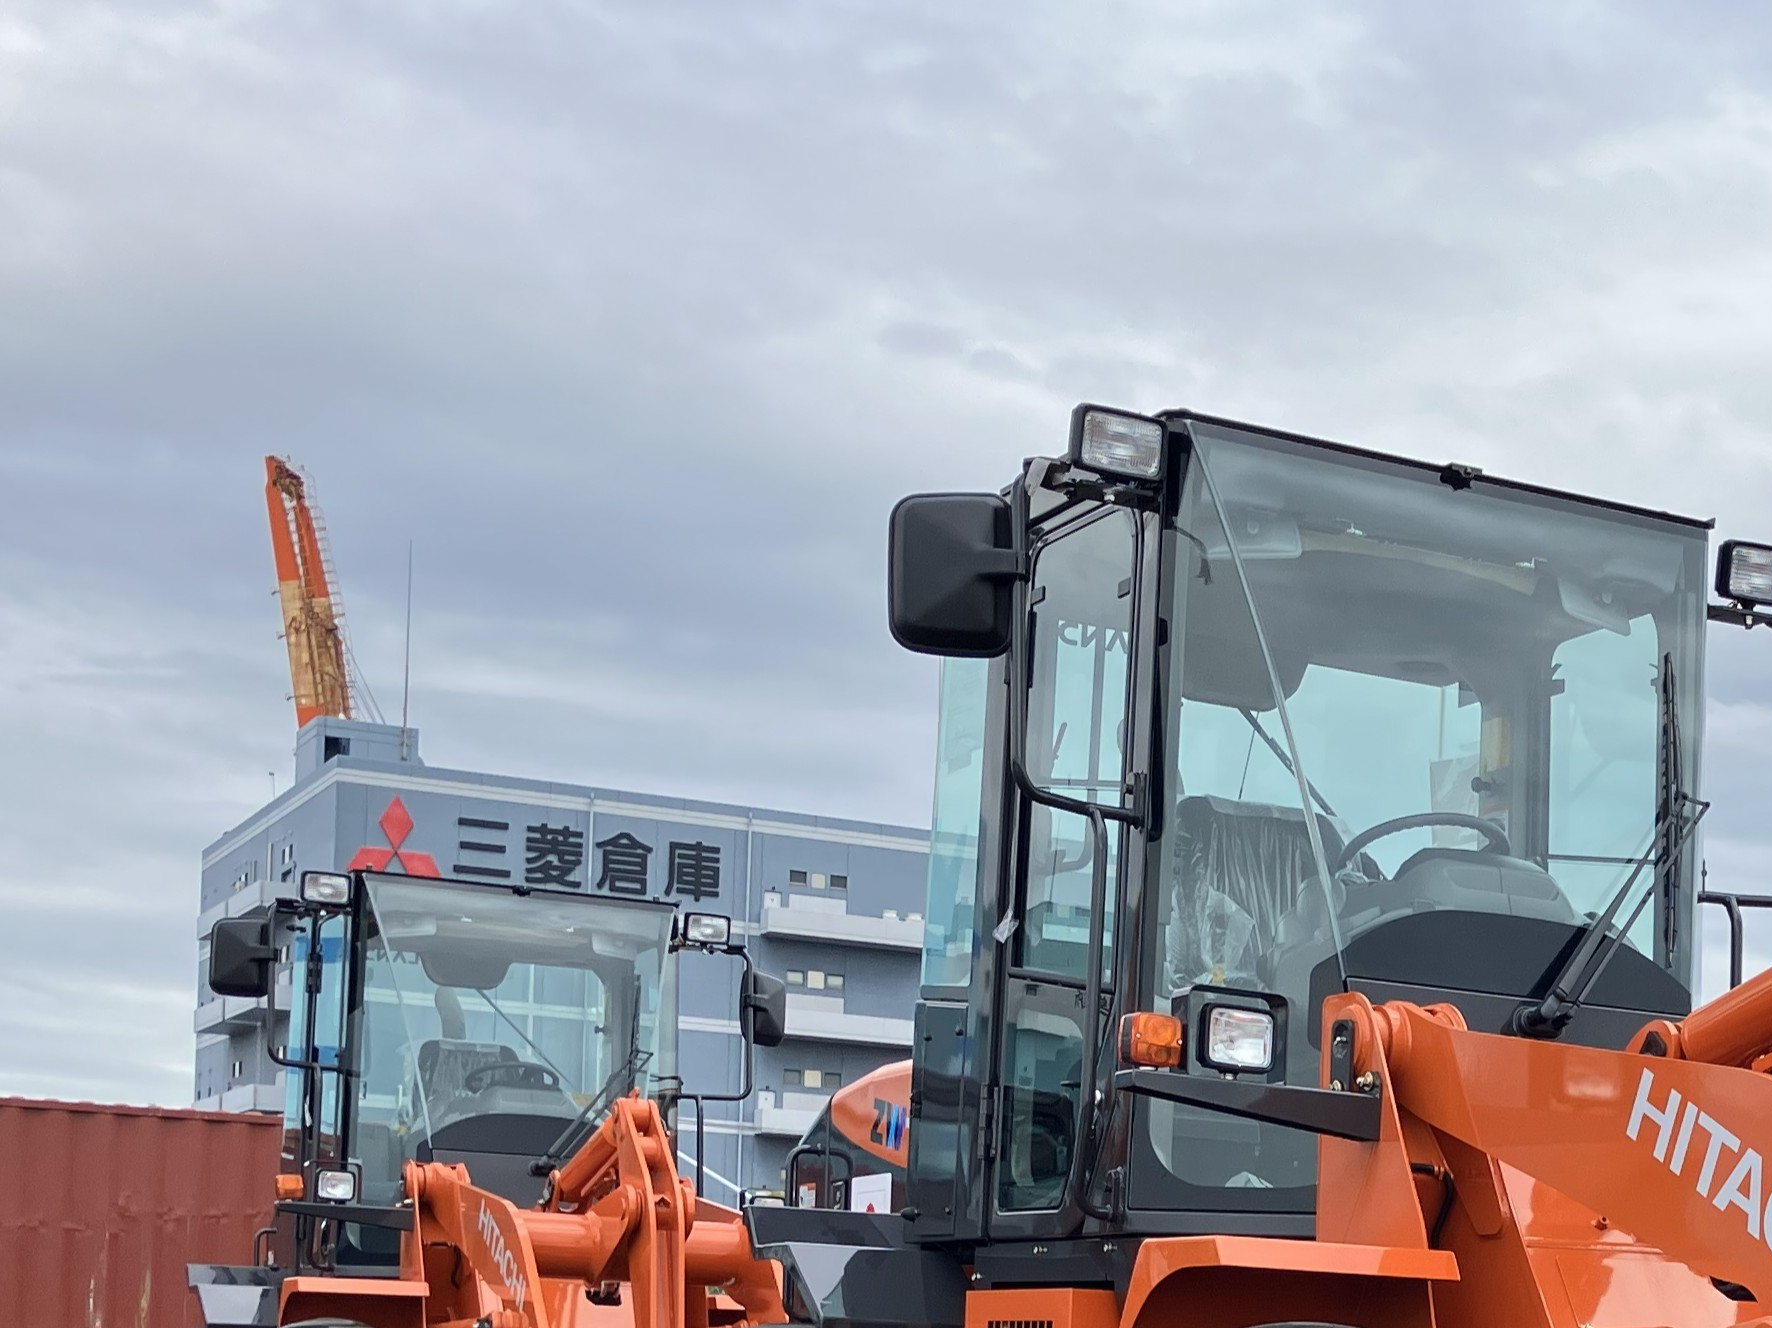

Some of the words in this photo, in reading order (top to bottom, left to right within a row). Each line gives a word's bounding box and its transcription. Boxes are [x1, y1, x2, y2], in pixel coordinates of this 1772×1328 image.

[453, 817, 721, 901] 三菱倉庫
[478, 1197, 526, 1312] HITACHI
